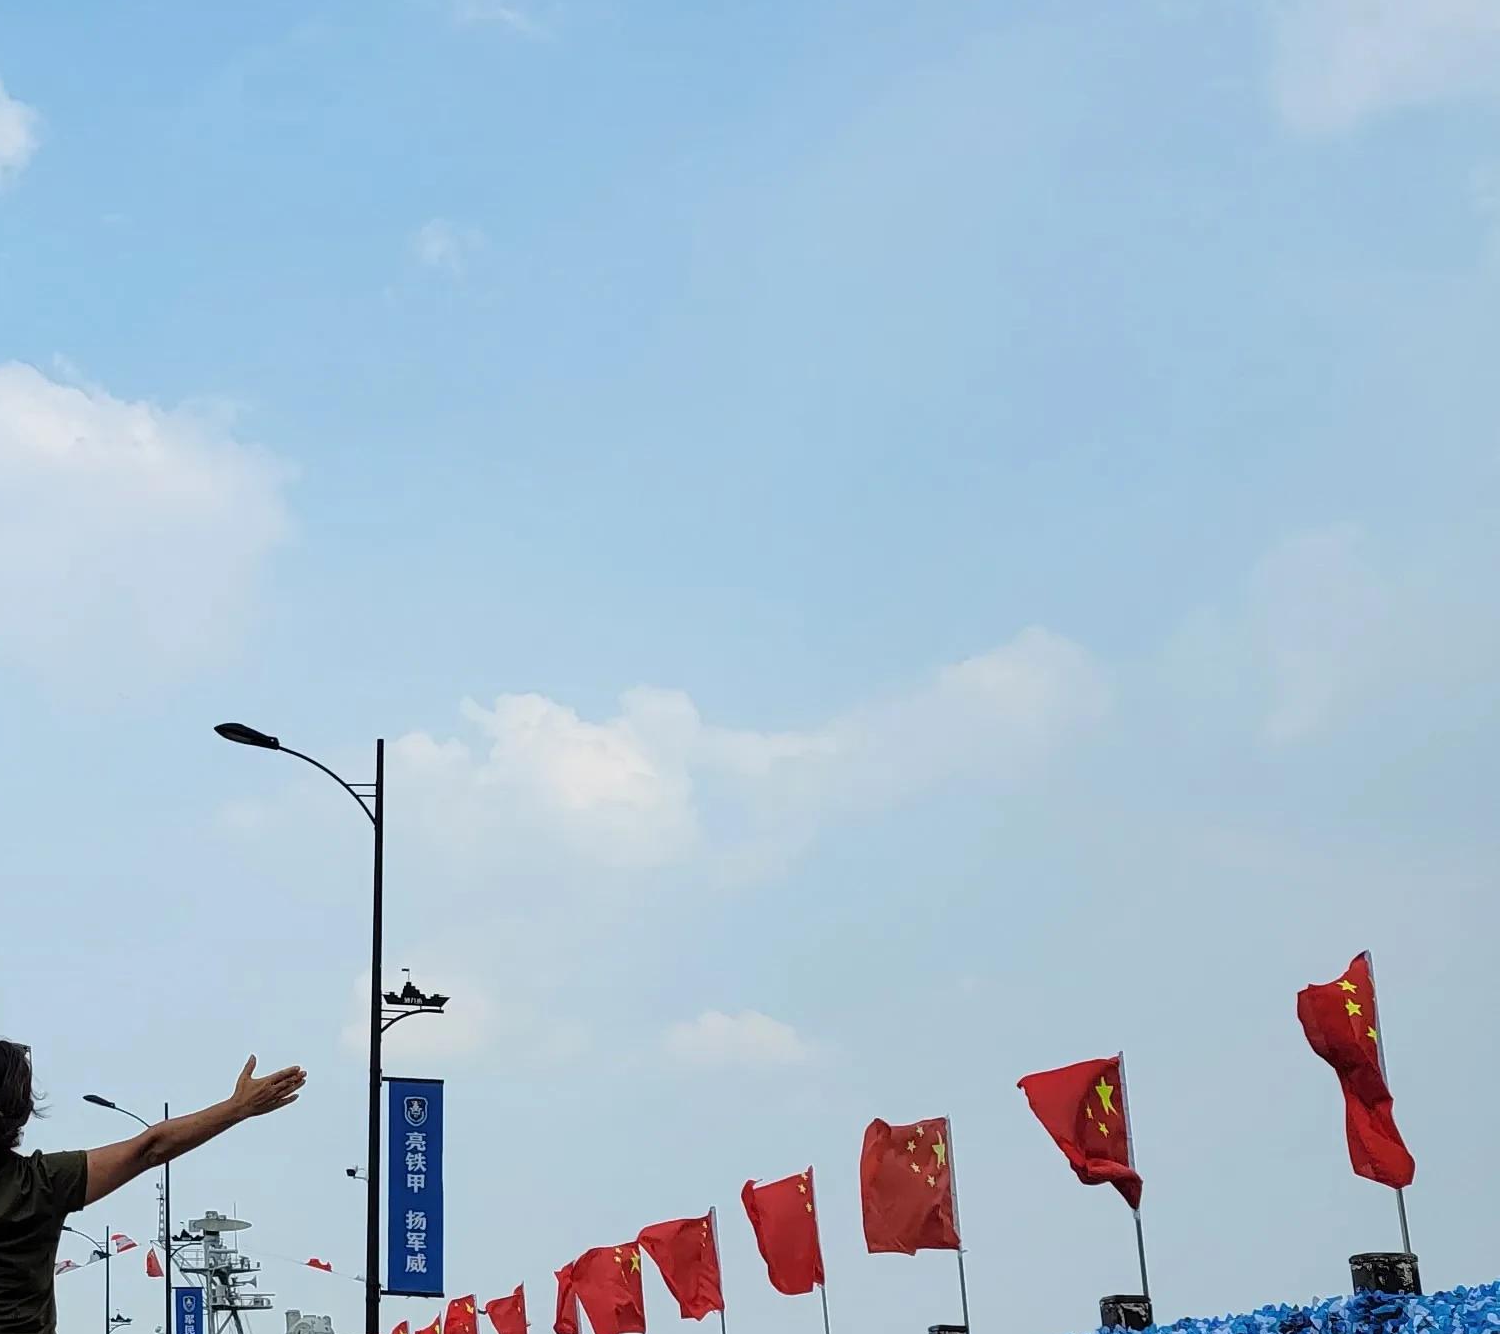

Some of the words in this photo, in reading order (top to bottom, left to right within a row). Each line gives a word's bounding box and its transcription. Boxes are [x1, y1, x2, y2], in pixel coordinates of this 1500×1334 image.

[404, 1132, 428, 1194] 亮铁甲
[404, 1210, 428, 1274] 扬军威
